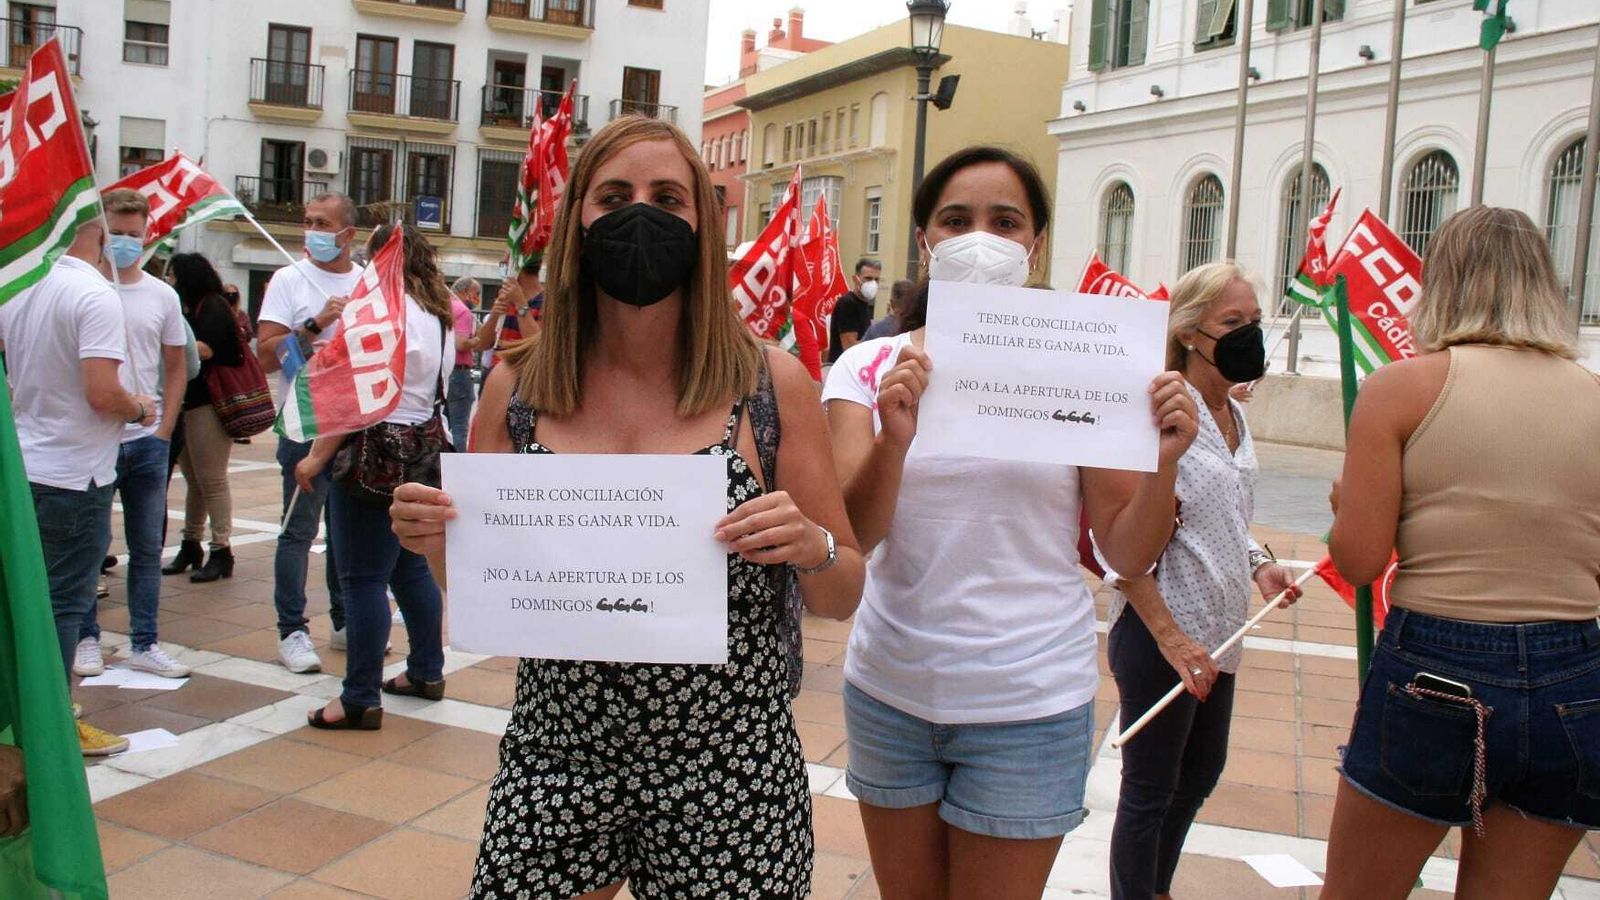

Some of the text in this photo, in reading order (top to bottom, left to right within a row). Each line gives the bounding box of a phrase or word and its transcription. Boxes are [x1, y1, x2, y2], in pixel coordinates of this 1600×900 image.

[977, 312, 1116, 334] TENER CONCILIACIÓN
[963, 333, 1128, 356] FAMILIAR ES GANAR VIDA.
[955, 379, 1128, 403] ¡NO A LA APERTURA DE LOS
[977, 405, 1049, 421] DOMINGOS
[497, 487, 664, 501] TENER CONCILIACIÓN
[484, 513, 680, 528] FAMILIAR ES GANAR VIDA.
[483, 568, 684, 584] ¡NO A LA APERTURA DE LOS
[512, 597, 592, 612] DOMINGOS
